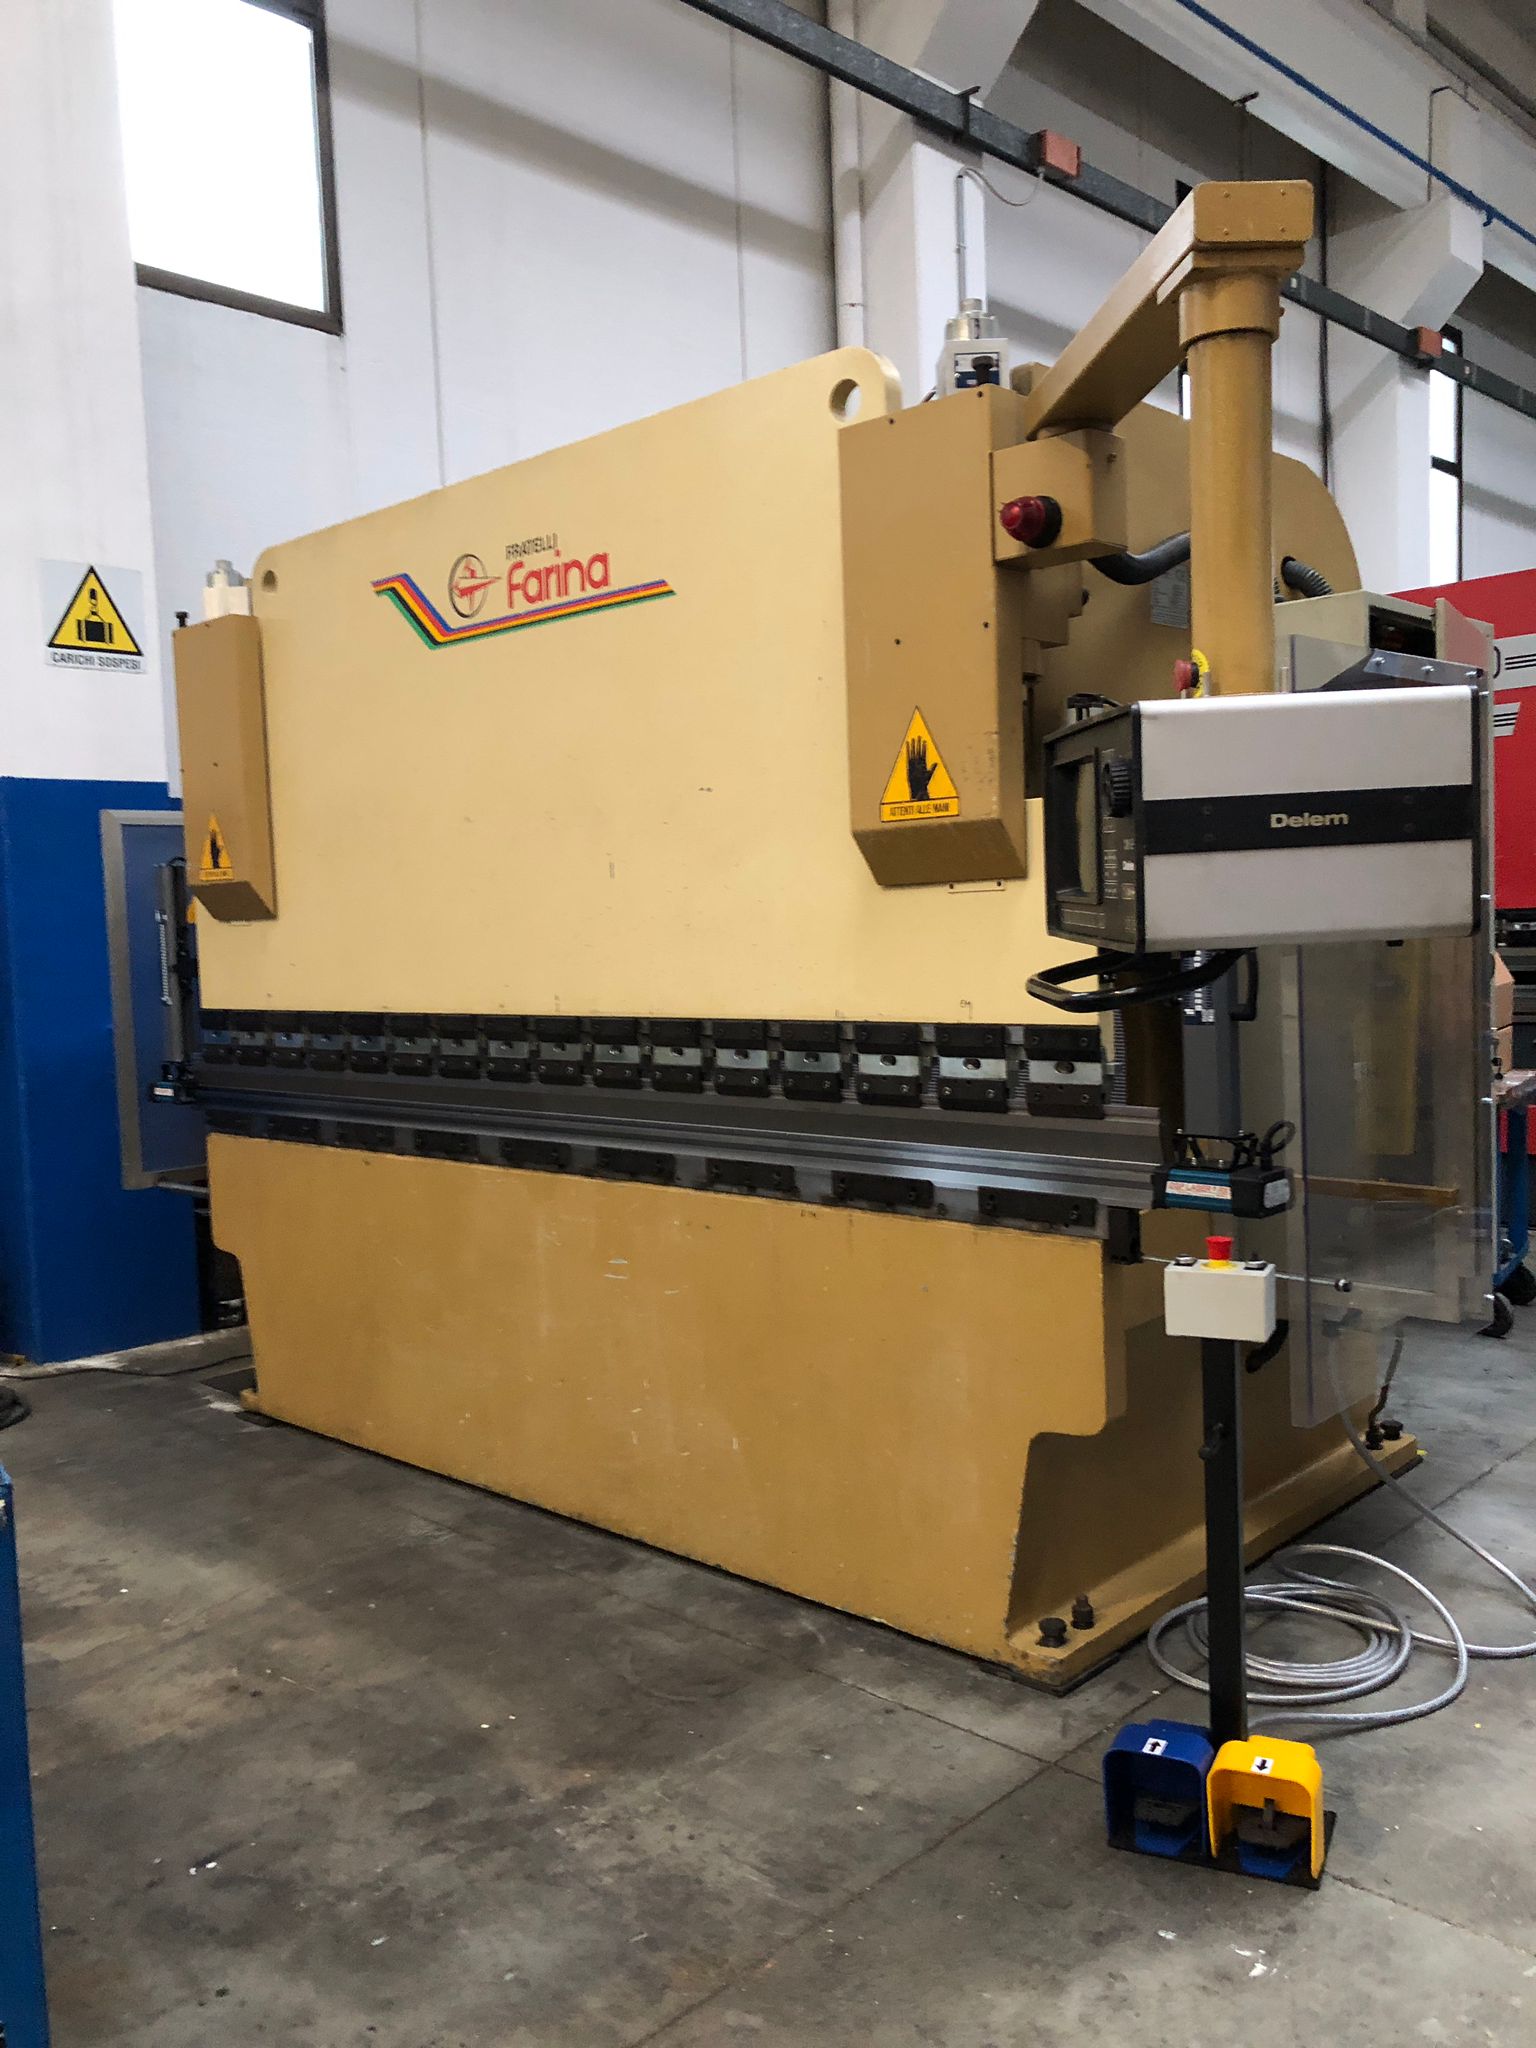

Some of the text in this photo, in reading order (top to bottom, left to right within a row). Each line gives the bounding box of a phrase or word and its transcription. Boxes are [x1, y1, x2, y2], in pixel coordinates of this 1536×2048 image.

[506, 533, 558, 560] FRATELLI
[52, 652, 141, 670] CARICHI SOSPESI
[1270, 812, 1349, 828] Delem
